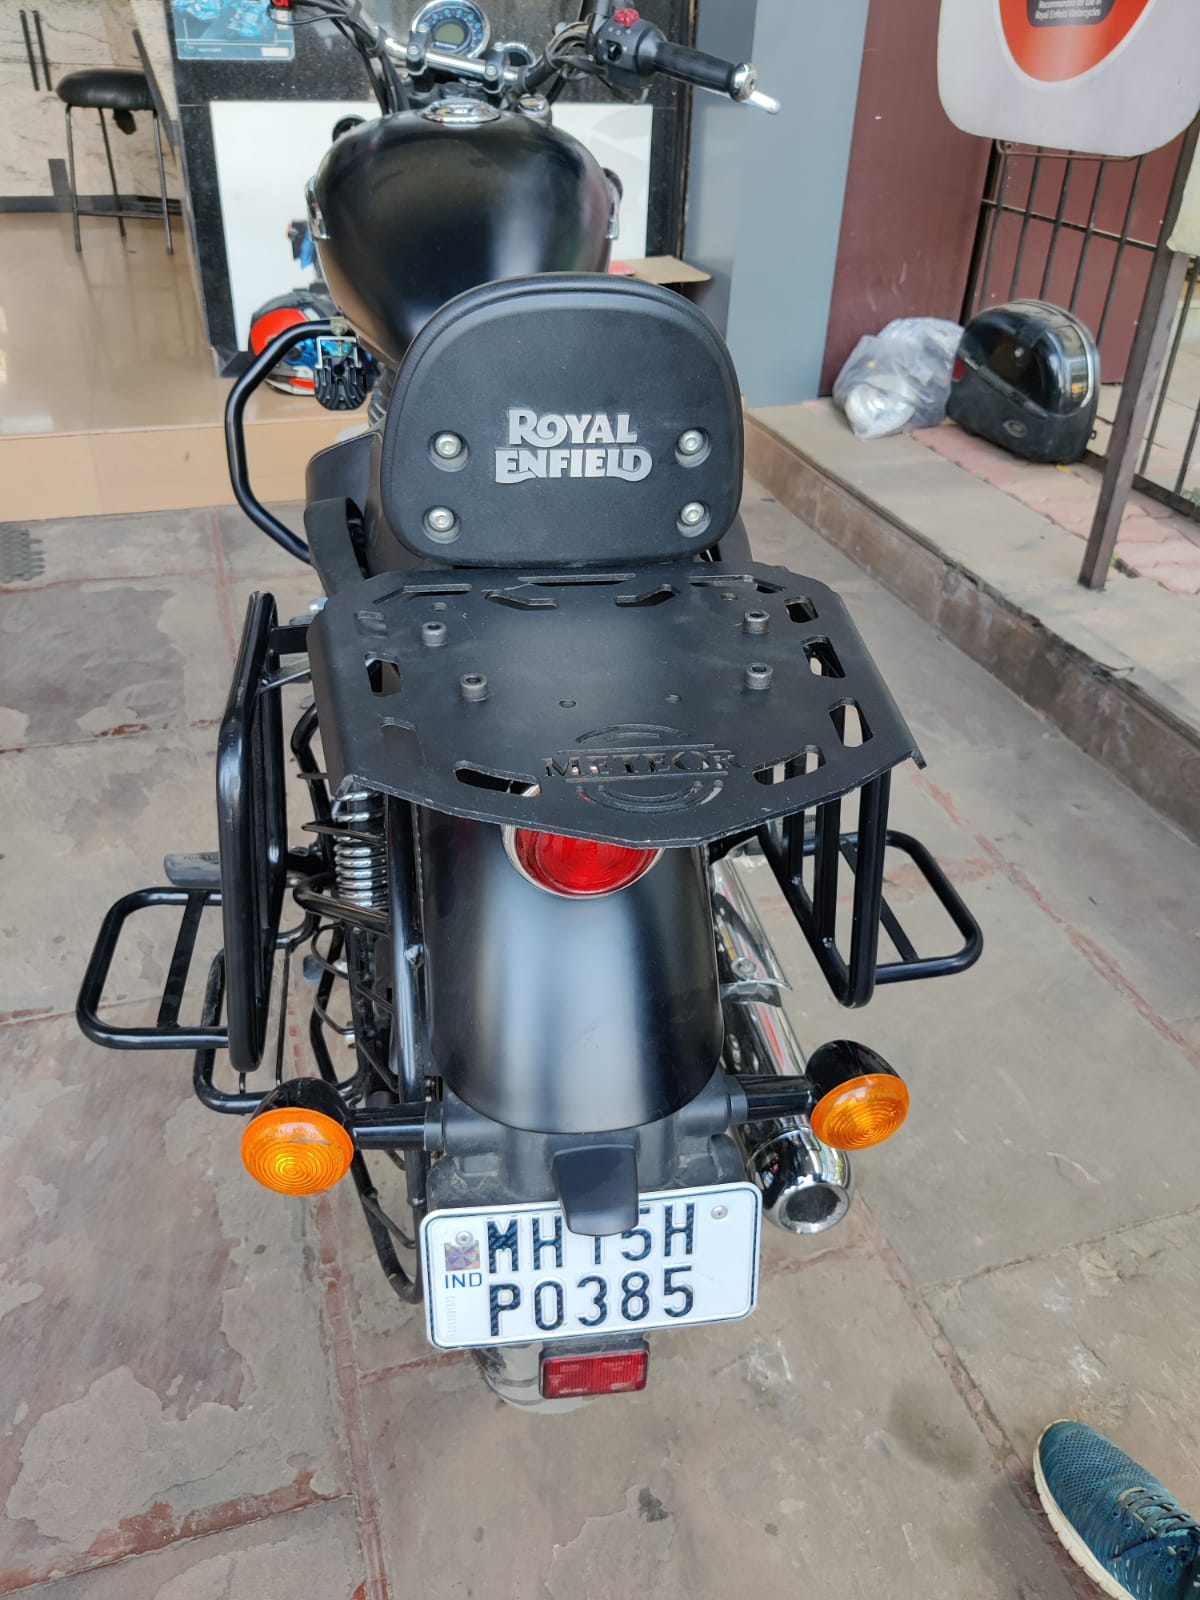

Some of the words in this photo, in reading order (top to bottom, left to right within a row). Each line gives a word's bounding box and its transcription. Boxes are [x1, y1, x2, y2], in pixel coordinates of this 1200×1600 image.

[508, 409, 638, 448] ROYAL
[495, 448, 652, 484] ENFIELD
[542, 750, 745, 777] METEOR
[445, 1272, 482, 1289] IND
[489, 1264, 694, 1337] P0385
